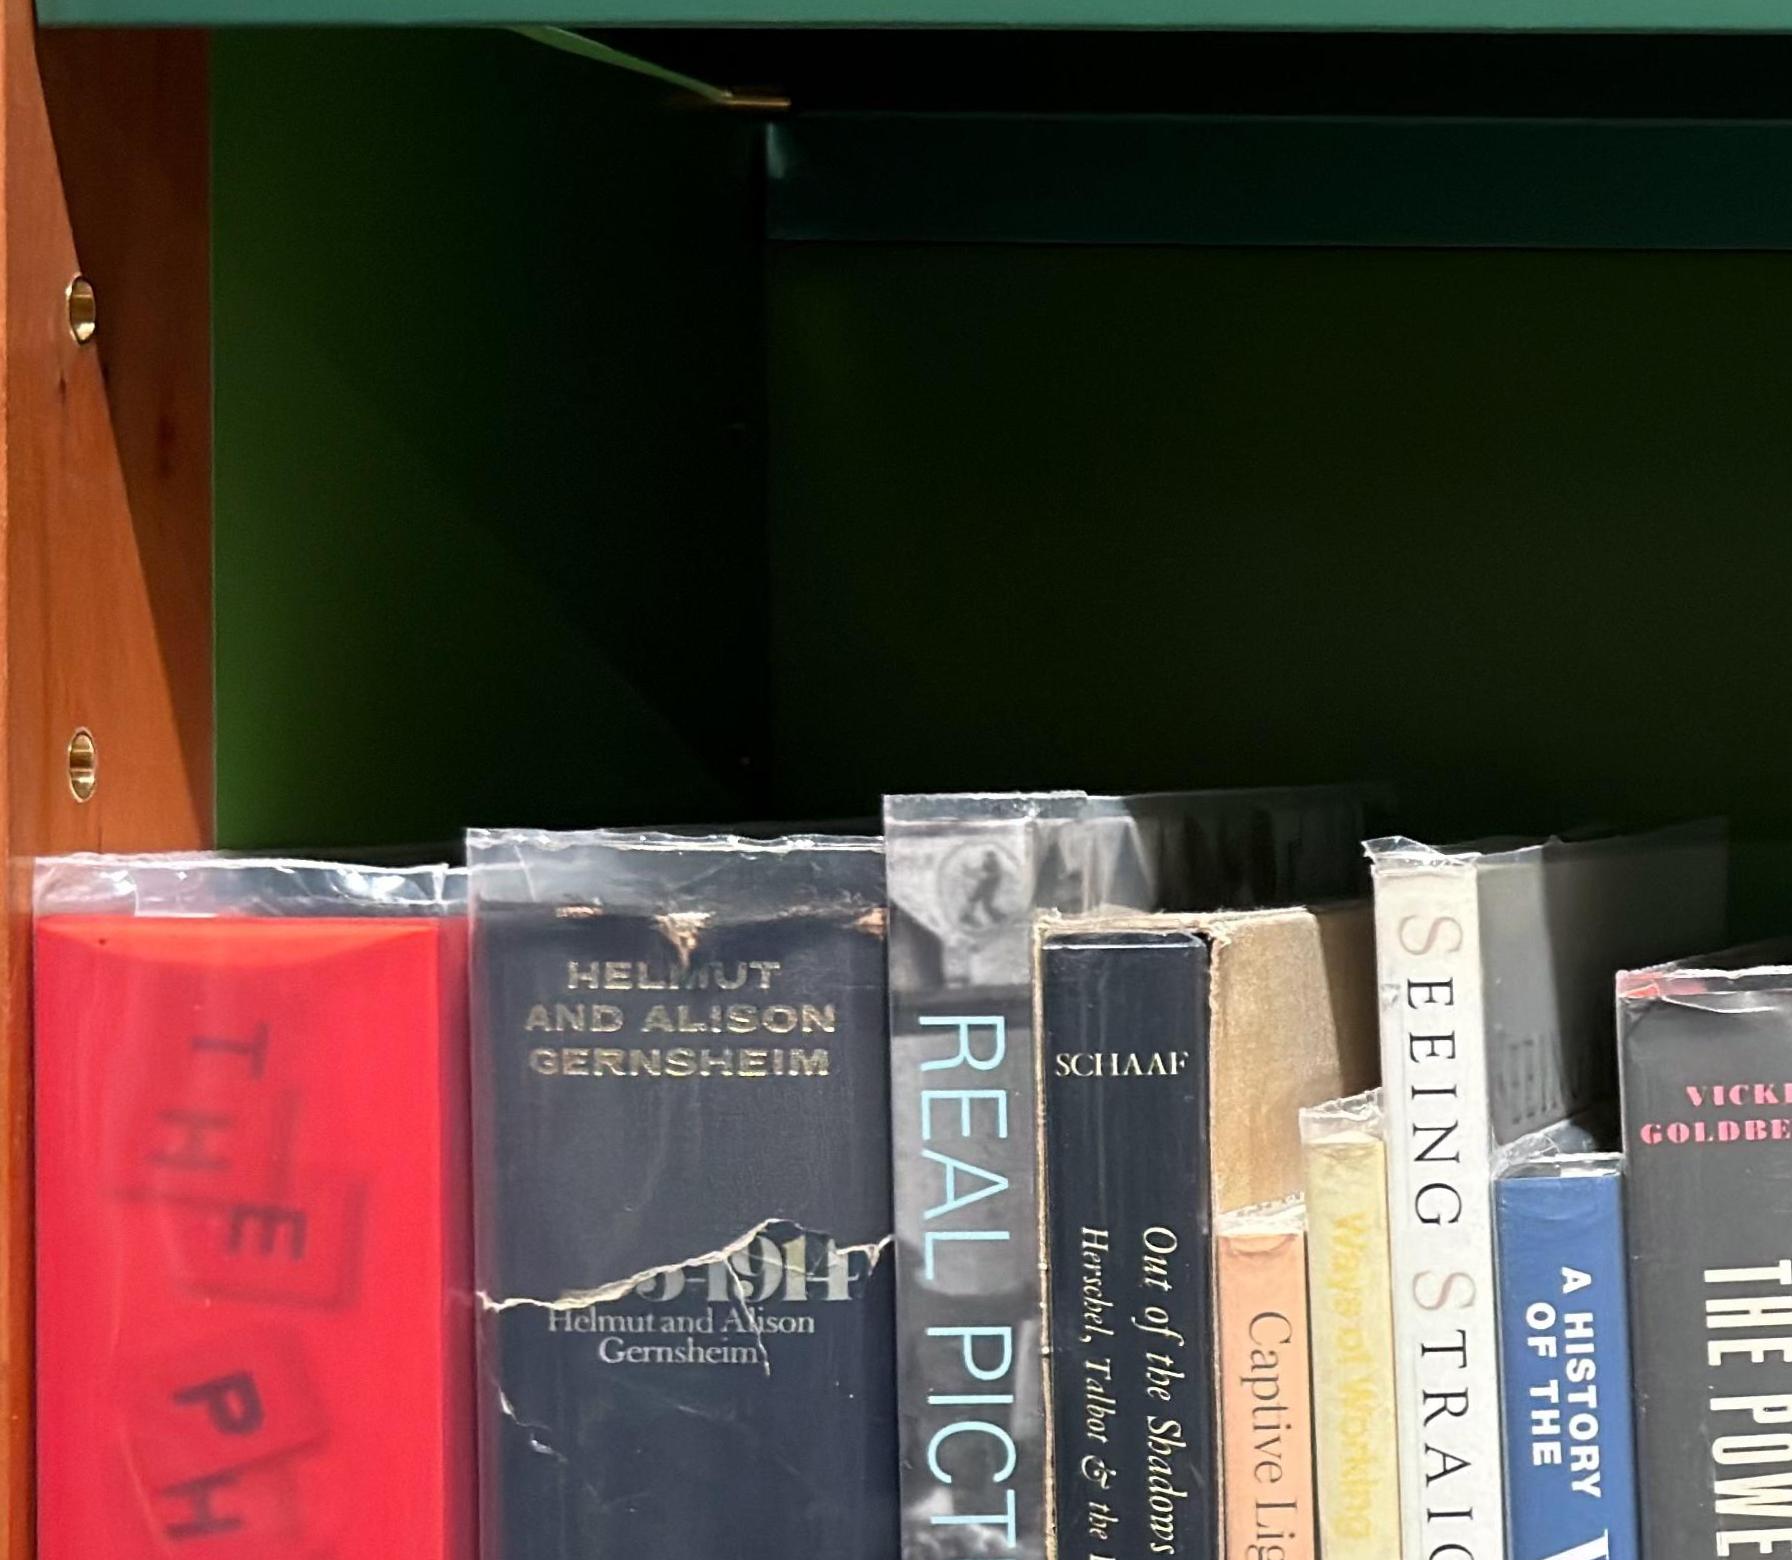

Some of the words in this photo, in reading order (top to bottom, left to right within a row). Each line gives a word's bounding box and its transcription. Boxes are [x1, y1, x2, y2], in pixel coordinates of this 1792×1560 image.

[567, 960, 781, 990] HELMUT
[525, 1005, 624, 1032] AND
[642, 1004, 836, 1033] ALISON
[530, 1049, 830, 1076] GERNSHEIM
[1056, 1052, 1188, 1076] SCHAAF
[1401, 914, 1462, 1226] SEEING
[148, 1018, 308, 1263] THE
[918, 1016, 1010, 1280] REAL
[1144, 1226, 1178, 1291] Out
[1561, 1266, 1592, 1294] A
[548, 1309, 655, 1333] Helmut
[661, 1306, 714, 1333] and
[722, 1306, 815, 1333] Alison
[1132, 1306, 1182, 1342] of
[1526, 1302, 1556, 1358] OF
[600, 1338, 758, 1363] Gernsheim
[1144, 1355, 1185, 1404] the
[1529, 1380, 1562, 1466] THE
[1563, 1312, 1601, 1499] HISTORY
[1146, 1414, 1186, 1555] Shadows
